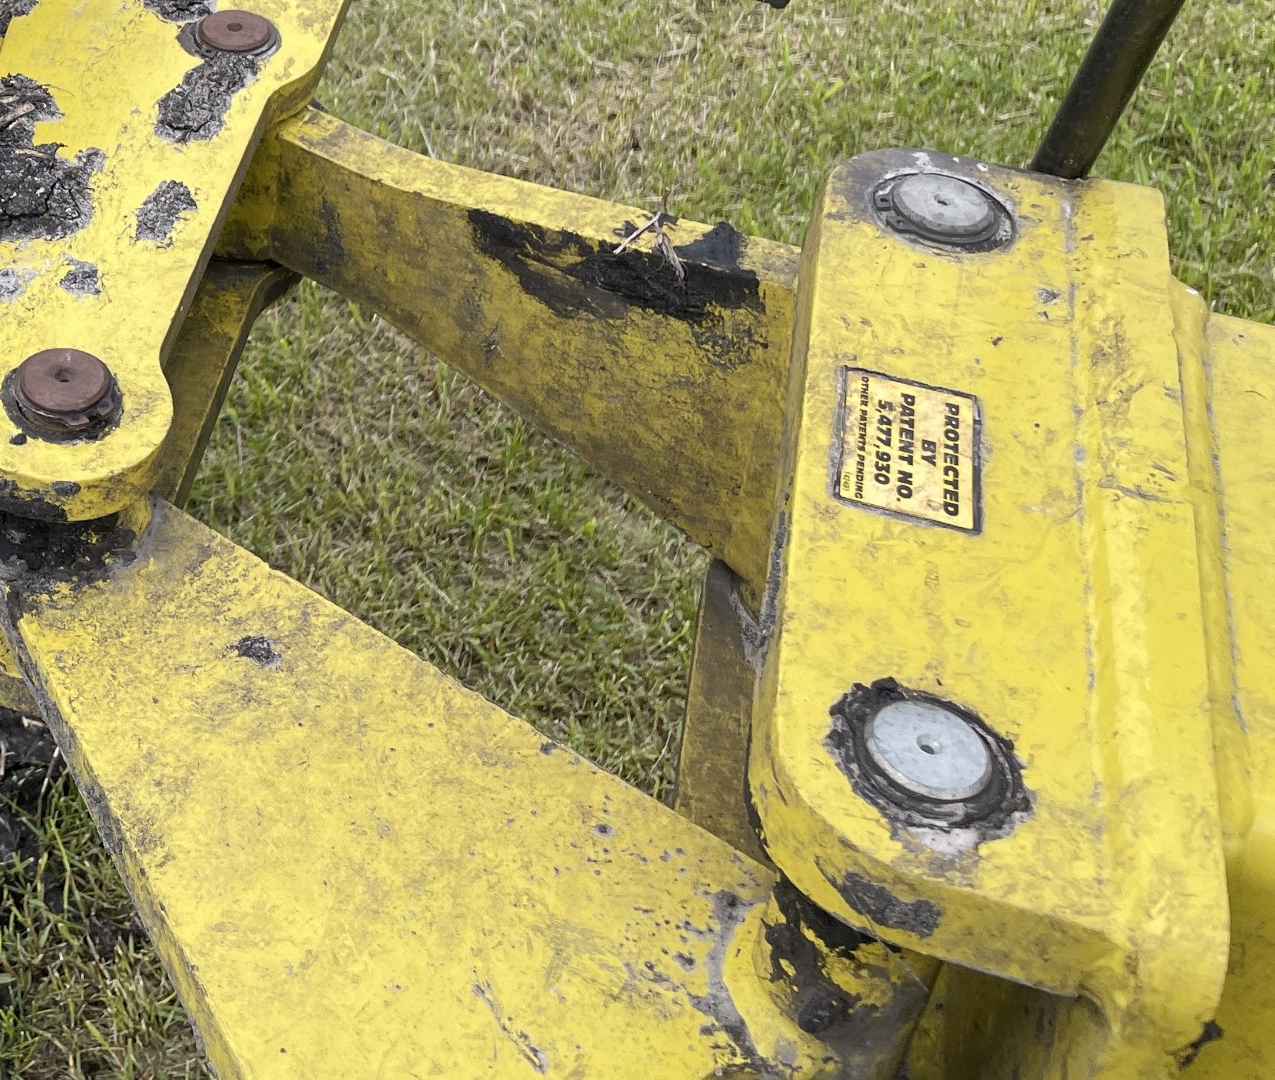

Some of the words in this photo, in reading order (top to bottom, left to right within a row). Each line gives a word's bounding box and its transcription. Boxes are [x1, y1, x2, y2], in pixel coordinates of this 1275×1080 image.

[860, 376, 869, 407] OTHER
[857, 409, 868, 452] PATENTS
[873, 399, 893, 485] 5,477,930
[898, 392, 916, 467] PATENT
[921, 439, 936, 467] BY
[943, 402, 960, 517] PROTECTED
[854, 453, 865, 499] PENDING
[896, 470, 914, 502] NO.
